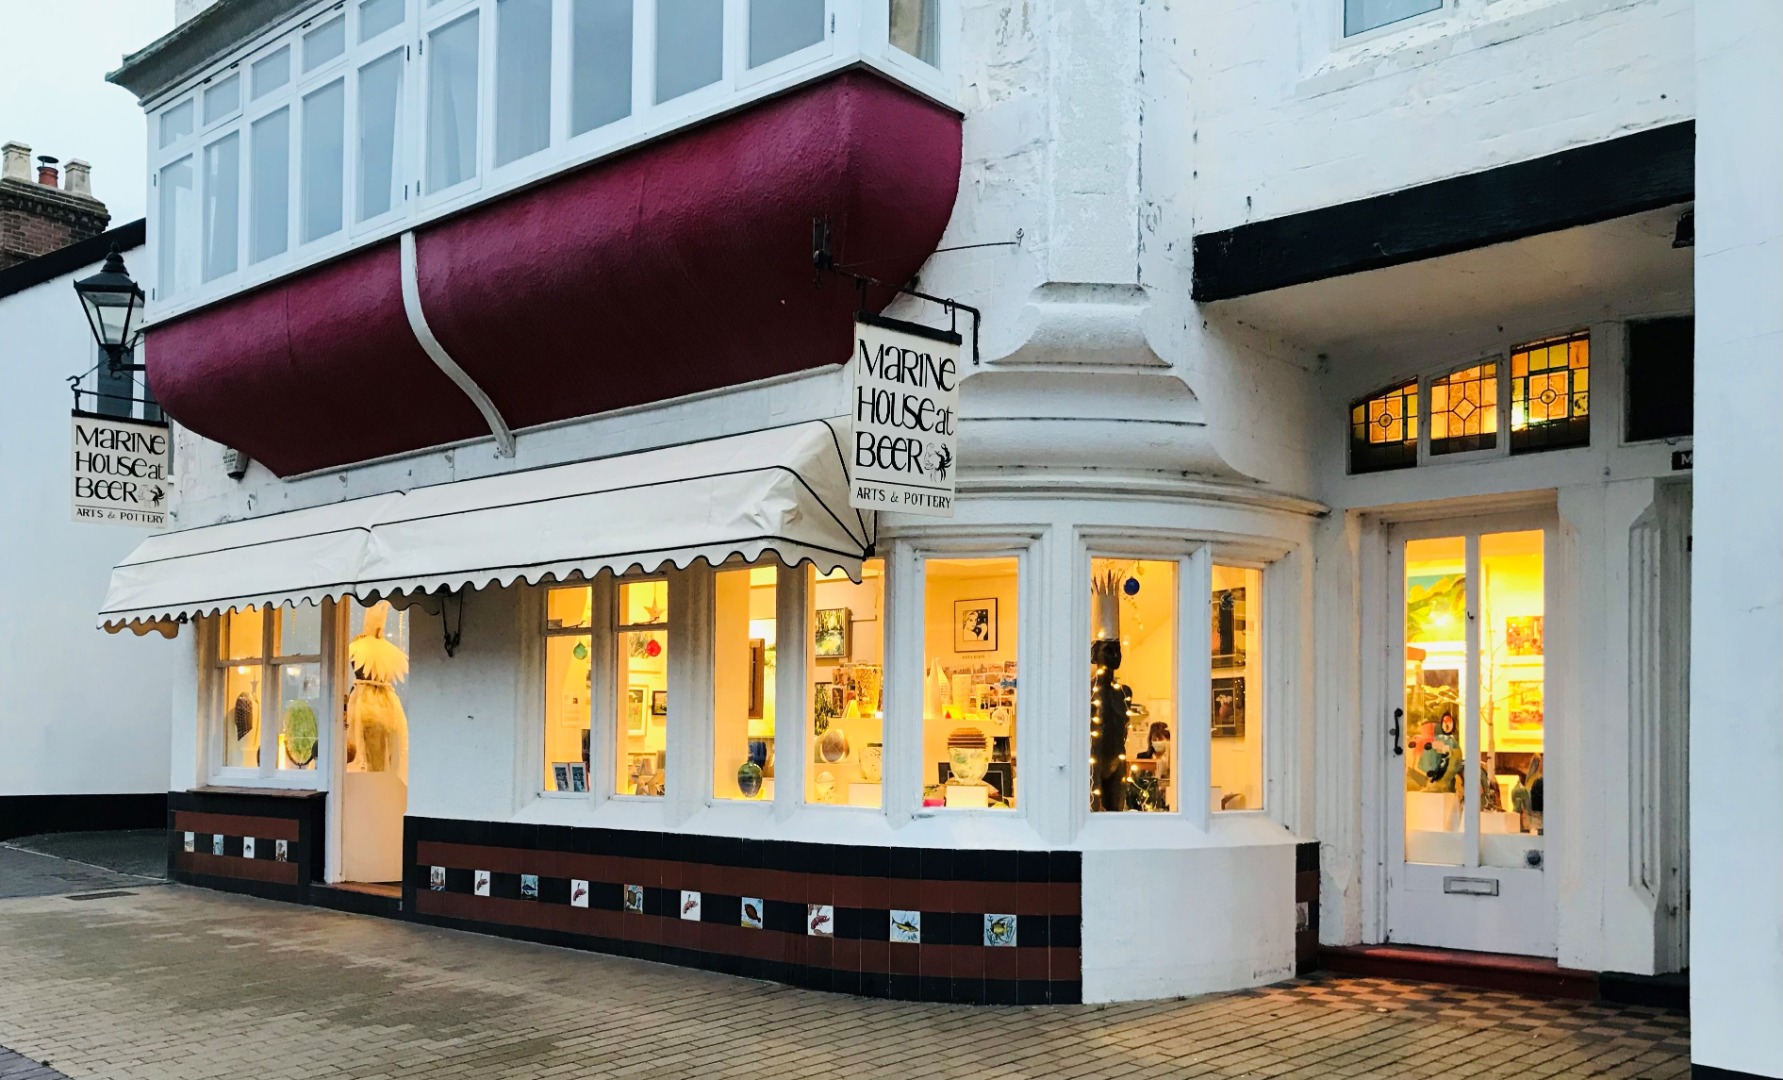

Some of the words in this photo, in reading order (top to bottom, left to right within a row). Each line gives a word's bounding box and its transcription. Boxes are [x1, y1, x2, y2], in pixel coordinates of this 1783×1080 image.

[934, 405, 954, 436] at
[147, 463, 165, 480] at
[856, 486, 886, 502] ARTS
[890, 491, 899, 503] &
[904, 492, 951, 509] POTTERY
[76, 508, 104, 518] ARTS
[107, 511, 116, 519] &
[120, 512, 165, 524] POTTERY
